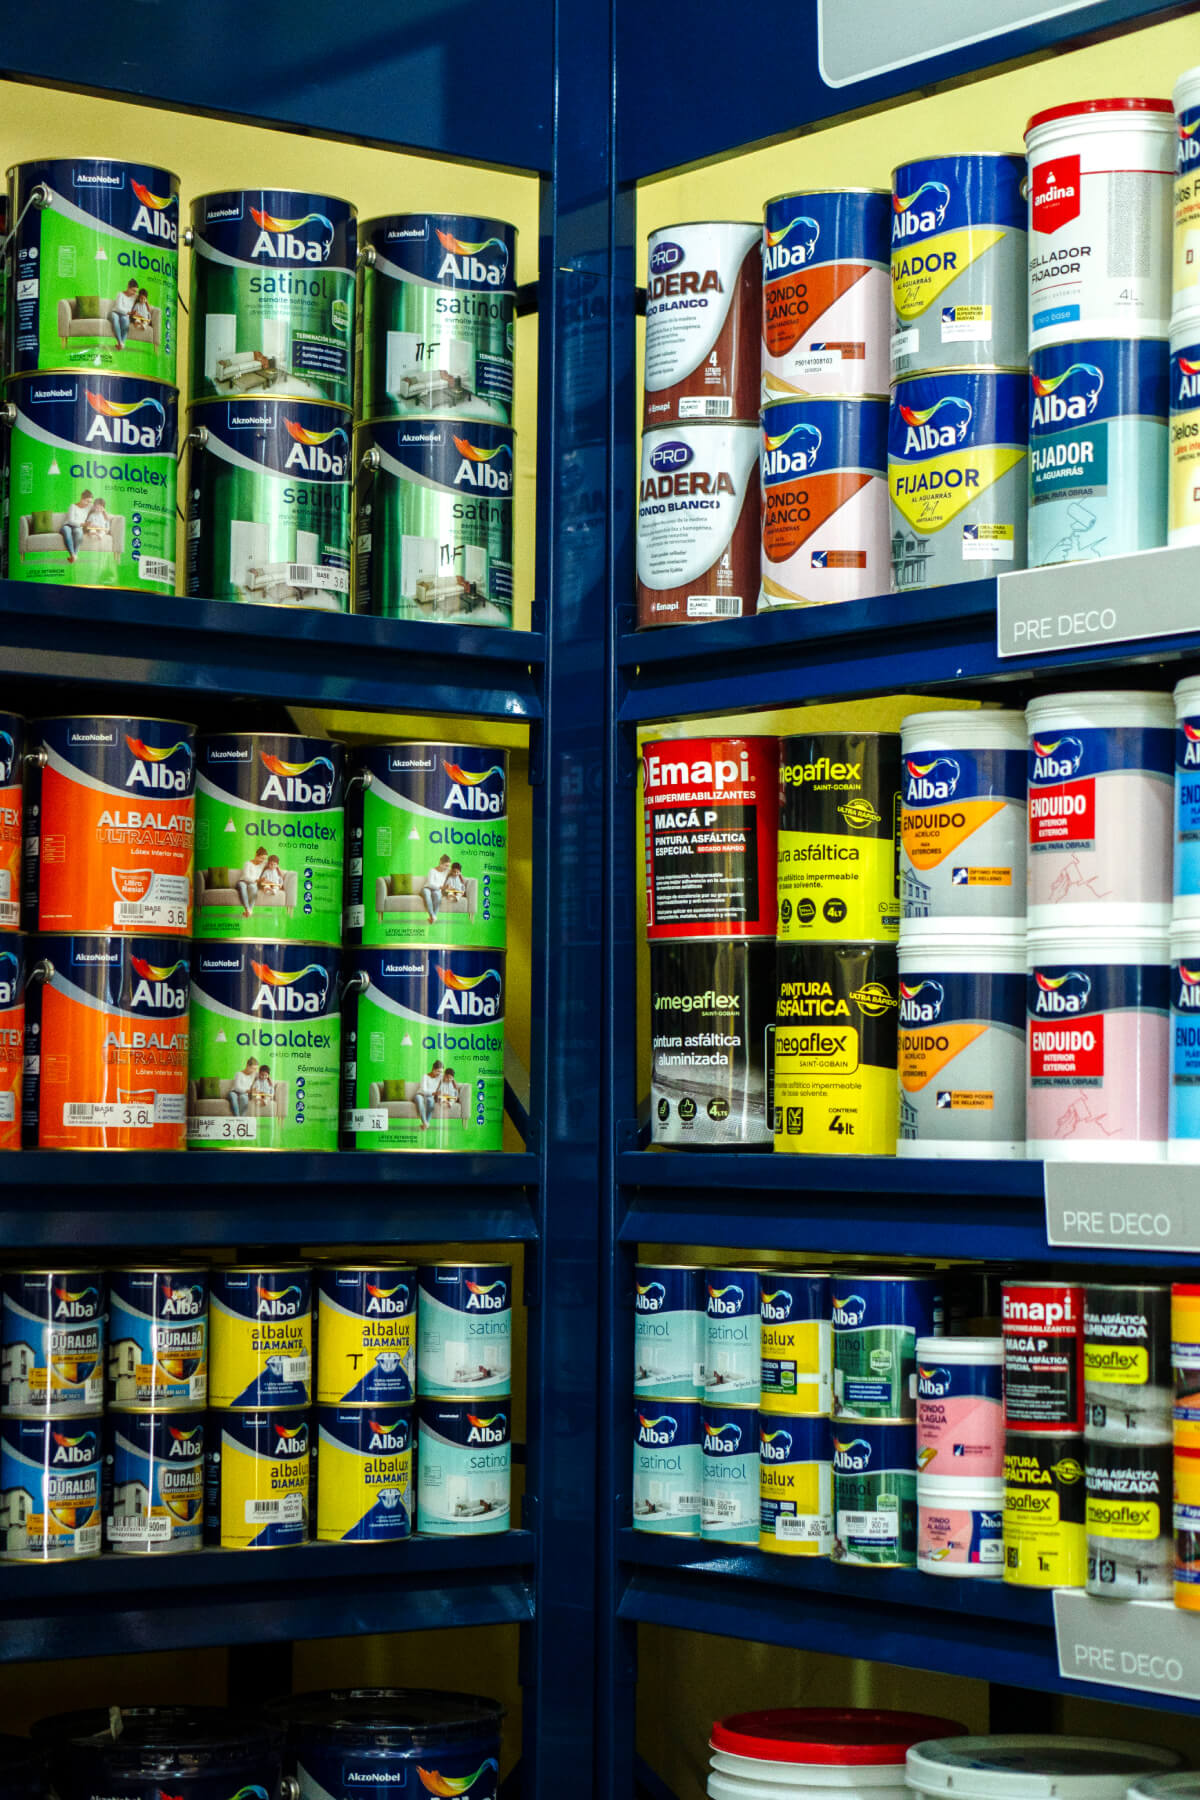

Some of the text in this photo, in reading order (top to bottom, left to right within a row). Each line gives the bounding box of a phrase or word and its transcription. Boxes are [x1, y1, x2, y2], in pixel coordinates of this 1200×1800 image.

[77, 174, 120, 184] AkzoNobel
[1035, 186, 1075, 206] andina
[206, 208, 240, 218] AkzoNobel
[132, 206, 178, 244] Alba
[892, 210, 936, 244] Alba
[250, 231, 322, 262] Alba
[651, 248, 678, 266] PRO
[766, 244, 806, 273] Alba
[437, 254, 500, 286] Alba
[250, 272, 328, 298] satinol
[648, 270, 724, 304] ADERA
[436, 296, 504, 320] satinol
[659, 299, 708, 314] BLANCO
[709, 351, 718, 366] 4
[34, 389, 72, 398] AkzoNobel
[1032, 394, 1086, 428] Alba
[86, 414, 156, 448] Alba
[402, 434, 441, 442] AkzoNobel
[904, 426, 956, 454] Alba
[285, 442, 344, 476] Alba
[653, 448, 688, 467] PRO
[763, 450, 807, 476] Alba
[1032, 441, 1094, 473] FIJADOR
[70, 461, 168, 488] albalatex
[454, 460, 509, 491] Alba
[1043, 466, 1084, 481] AGUARRÁS
[896, 469, 979, 496] FIJADOR
[1068, 487, 1093, 498] OBRAS
[668, 500, 720, 513] BLANCO
[722, 554, 728, 568] 4
[1014, 608, 1116, 642] PRE DECO
[72, 734, 113, 742] AkzoNobel
[210, 750, 248, 758] AkzoNobel
[126, 760, 186, 792] Alba
[1033, 758, 1072, 780] Alba
[260, 775, 326, 804] Alba
[813, 784, 862, 792] SAINT-GOBAIN
[907, 778, 949, 801] Alba
[444, 784, 500, 813] Alba
[654, 790, 756, 804] IMPERMEABILIZANTES
[837, 806, 882, 823] ULTRA RÁPIDO
[1030, 794, 1086, 818] ENDUIDO
[655, 808, 718, 830] MACÁ P
[904, 813, 966, 831] ENDUIDO
[1039, 818, 1068, 827] INTERIOR
[246, 820, 336, 842] albalatex
[656, 832, 746, 846] PINTURA ASFÁLTICA
[1038, 827, 1068, 838] EXTERIOR
[299, 842, 318, 850] mate
[656, 846, 694, 856] ESPECIAL
[794, 844, 860, 862] asfáltica
[1065, 842, 1090, 850] OBRAS
[806, 873, 859, 882] impermeable
[827, 906, 842, 918] 4LT
[76, 954, 118, 962] AkzoNobel
[202, 960, 239, 968] AkzoNobel
[386, 964, 424, 972] AkzoNobel
[130, 980, 185, 1008] Alba
[252, 984, 320, 1012] Alba
[781, 982, 832, 997] PINTURA
[436, 988, 496, 1016] Alba
[849, 992, 898, 1006] ULTRA RÁPIDO
[1036, 990, 1080, 1012] Alba
[900, 999, 933, 1021] Alba
[236, 1029, 330, 1048] albalatex
[422, 1033, 502, 1052] albalatex
[654, 1034, 740, 1049] pintura asfáltica
[1033, 1030, 1094, 1052] ENDUIDO
[291, 1051, 312, 1059] mate
[658, 1052, 728, 1066] aluminizada
[1044, 1054, 1075, 1062] INTERIOR
[800, 1060, 848, 1068] SAINT-GOBAIN
[1043, 1063, 1076, 1072] EXTERIOR
[812, 1082, 862, 1090] impermeable
[1053, 1078, 1098, 1086] PARA OBRAS
[123, 1110, 152, 1126] 3,6L
[222, 1123, 254, 1138] 3,6L
[1064, 1210, 1171, 1236] PRE DECO
[55, 1301, 94, 1318] Alba
[161, 1299, 200, 1316] Alba
[256, 1300, 296, 1316] Alba
[366, 1296, 404, 1314] Alba
[466, 1294, 503, 1310] Alba
[636, 1294, 659, 1310] Alba
[708, 1297, 736, 1314] Alba
[760, 1304, 784, 1320] Alba
[832, 1308, 858, 1326] Alba
[1101, 1312, 1148, 1326] ASFÁLTICA
[251, 1325, 303, 1340] albalux
[362, 1322, 410, 1336] albalux
[52, 1333, 97, 1350] DURALBA
[252, 1339, 302, 1351] DIAMANTE
[362, 1337, 410, 1348] DIAMANTE
[1037, 1339, 1048, 1352] P
[346, 1354, 364, 1370] T
[1028, 1355, 1068, 1365] ASFÁLTICA
[918, 1378, 944, 1396] Alba
[926, 1414, 948, 1425] AGUA
[368, 1433, 404, 1450] Alba
[467, 1428, 503, 1443] Alba
[638, 1427, 670, 1444] Alba
[704, 1434, 734, 1452] Alba
[168, 1440, 200, 1457] Alba
[274, 1437, 306, 1455] Alba
[760, 1442, 785, 1460] Alba
[52, 1446, 92, 1464] Alba
[640, 1455, 682, 1470] satinol
[833, 1450, 864, 1470] Alba
[364, 1458, 408, 1473] albalux
[364, 1472, 408, 1484] DIAMANTE
[1110, 1468, 1159, 1481] ASFÁLTICA
[49, 1478, 96, 1495] DURALBA
[1074, 1644, 1183, 1682] PRE DECO
[348, 1772, 400, 1782] AkzoNobel
